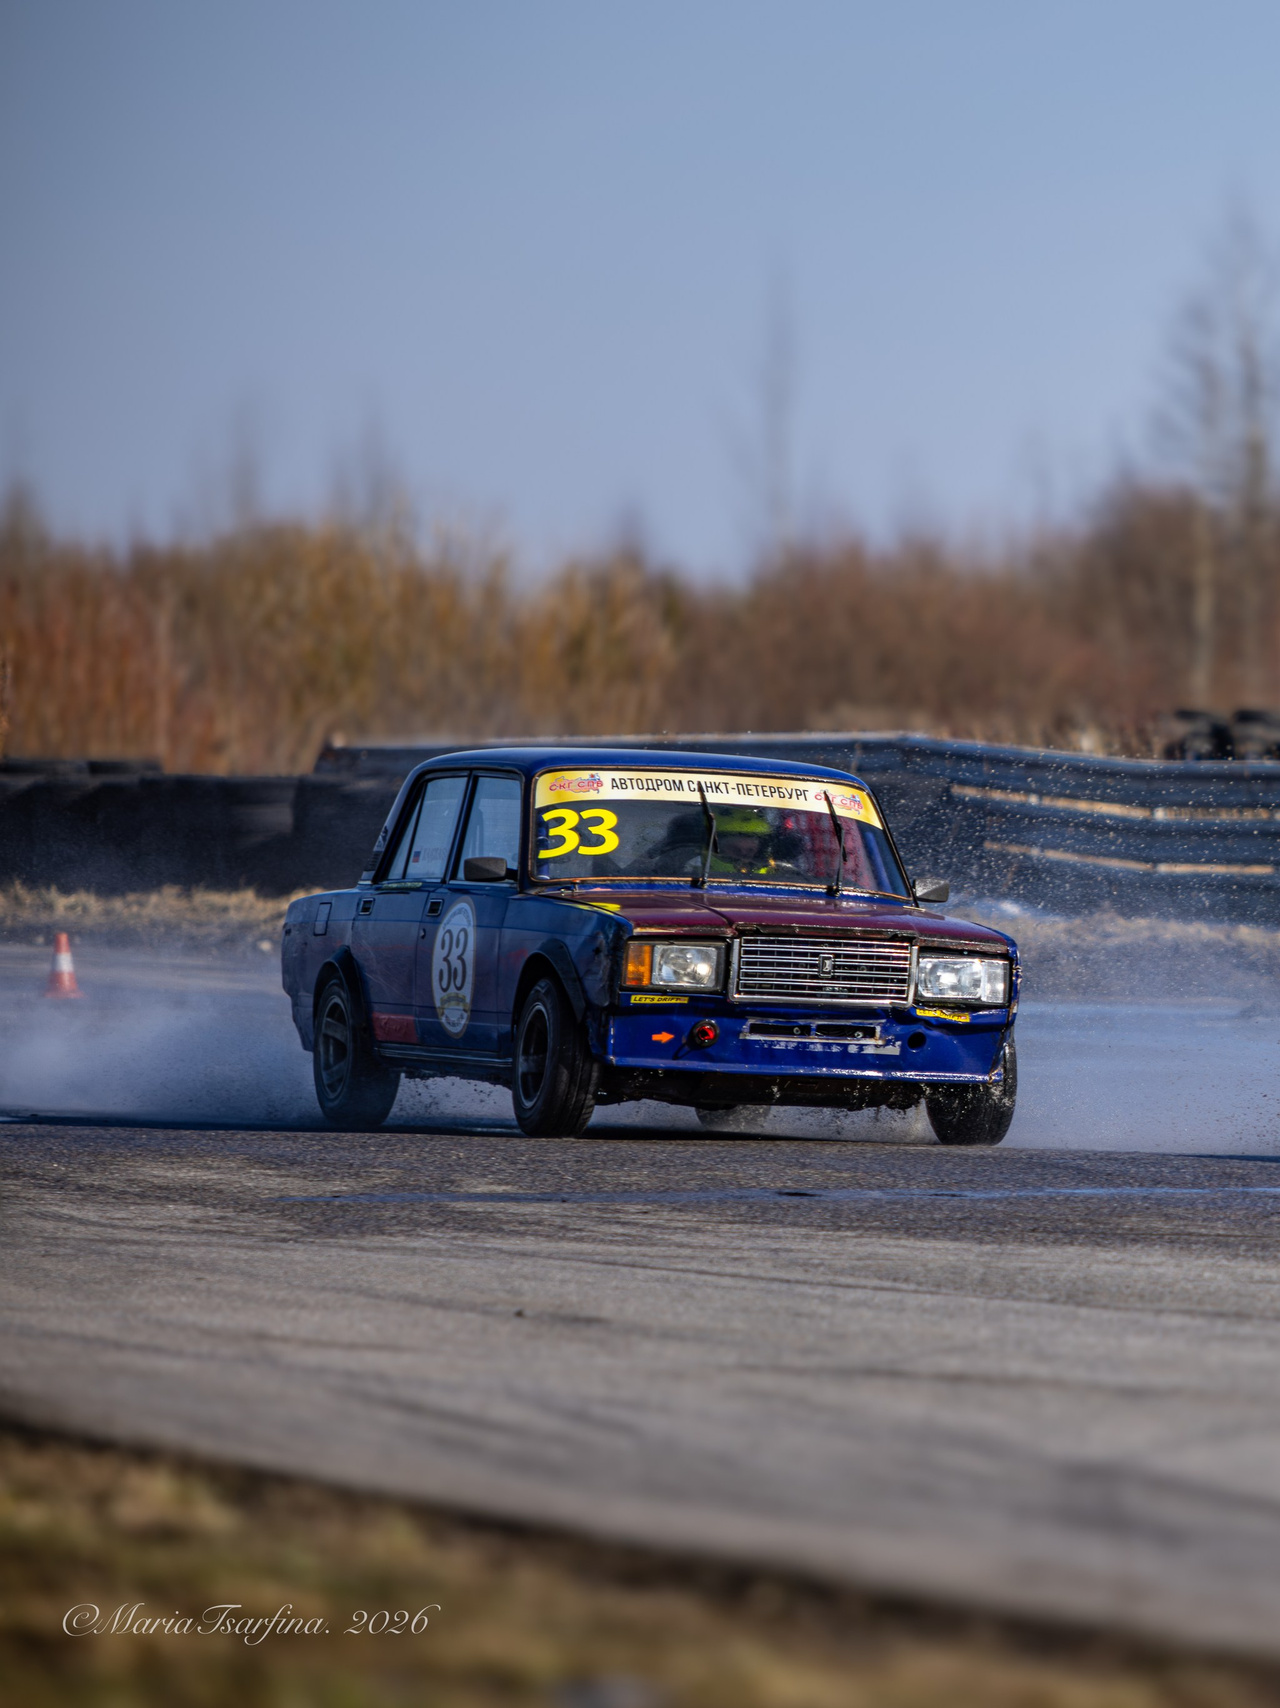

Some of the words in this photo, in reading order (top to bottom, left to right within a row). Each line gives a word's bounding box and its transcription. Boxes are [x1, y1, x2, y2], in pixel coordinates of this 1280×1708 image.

[611, 777, 684, 792] АВТОДРОМ
[814, 793, 836, 803] СГ
[538, 808, 620, 859] 33
[439, 928, 469, 993] 33
